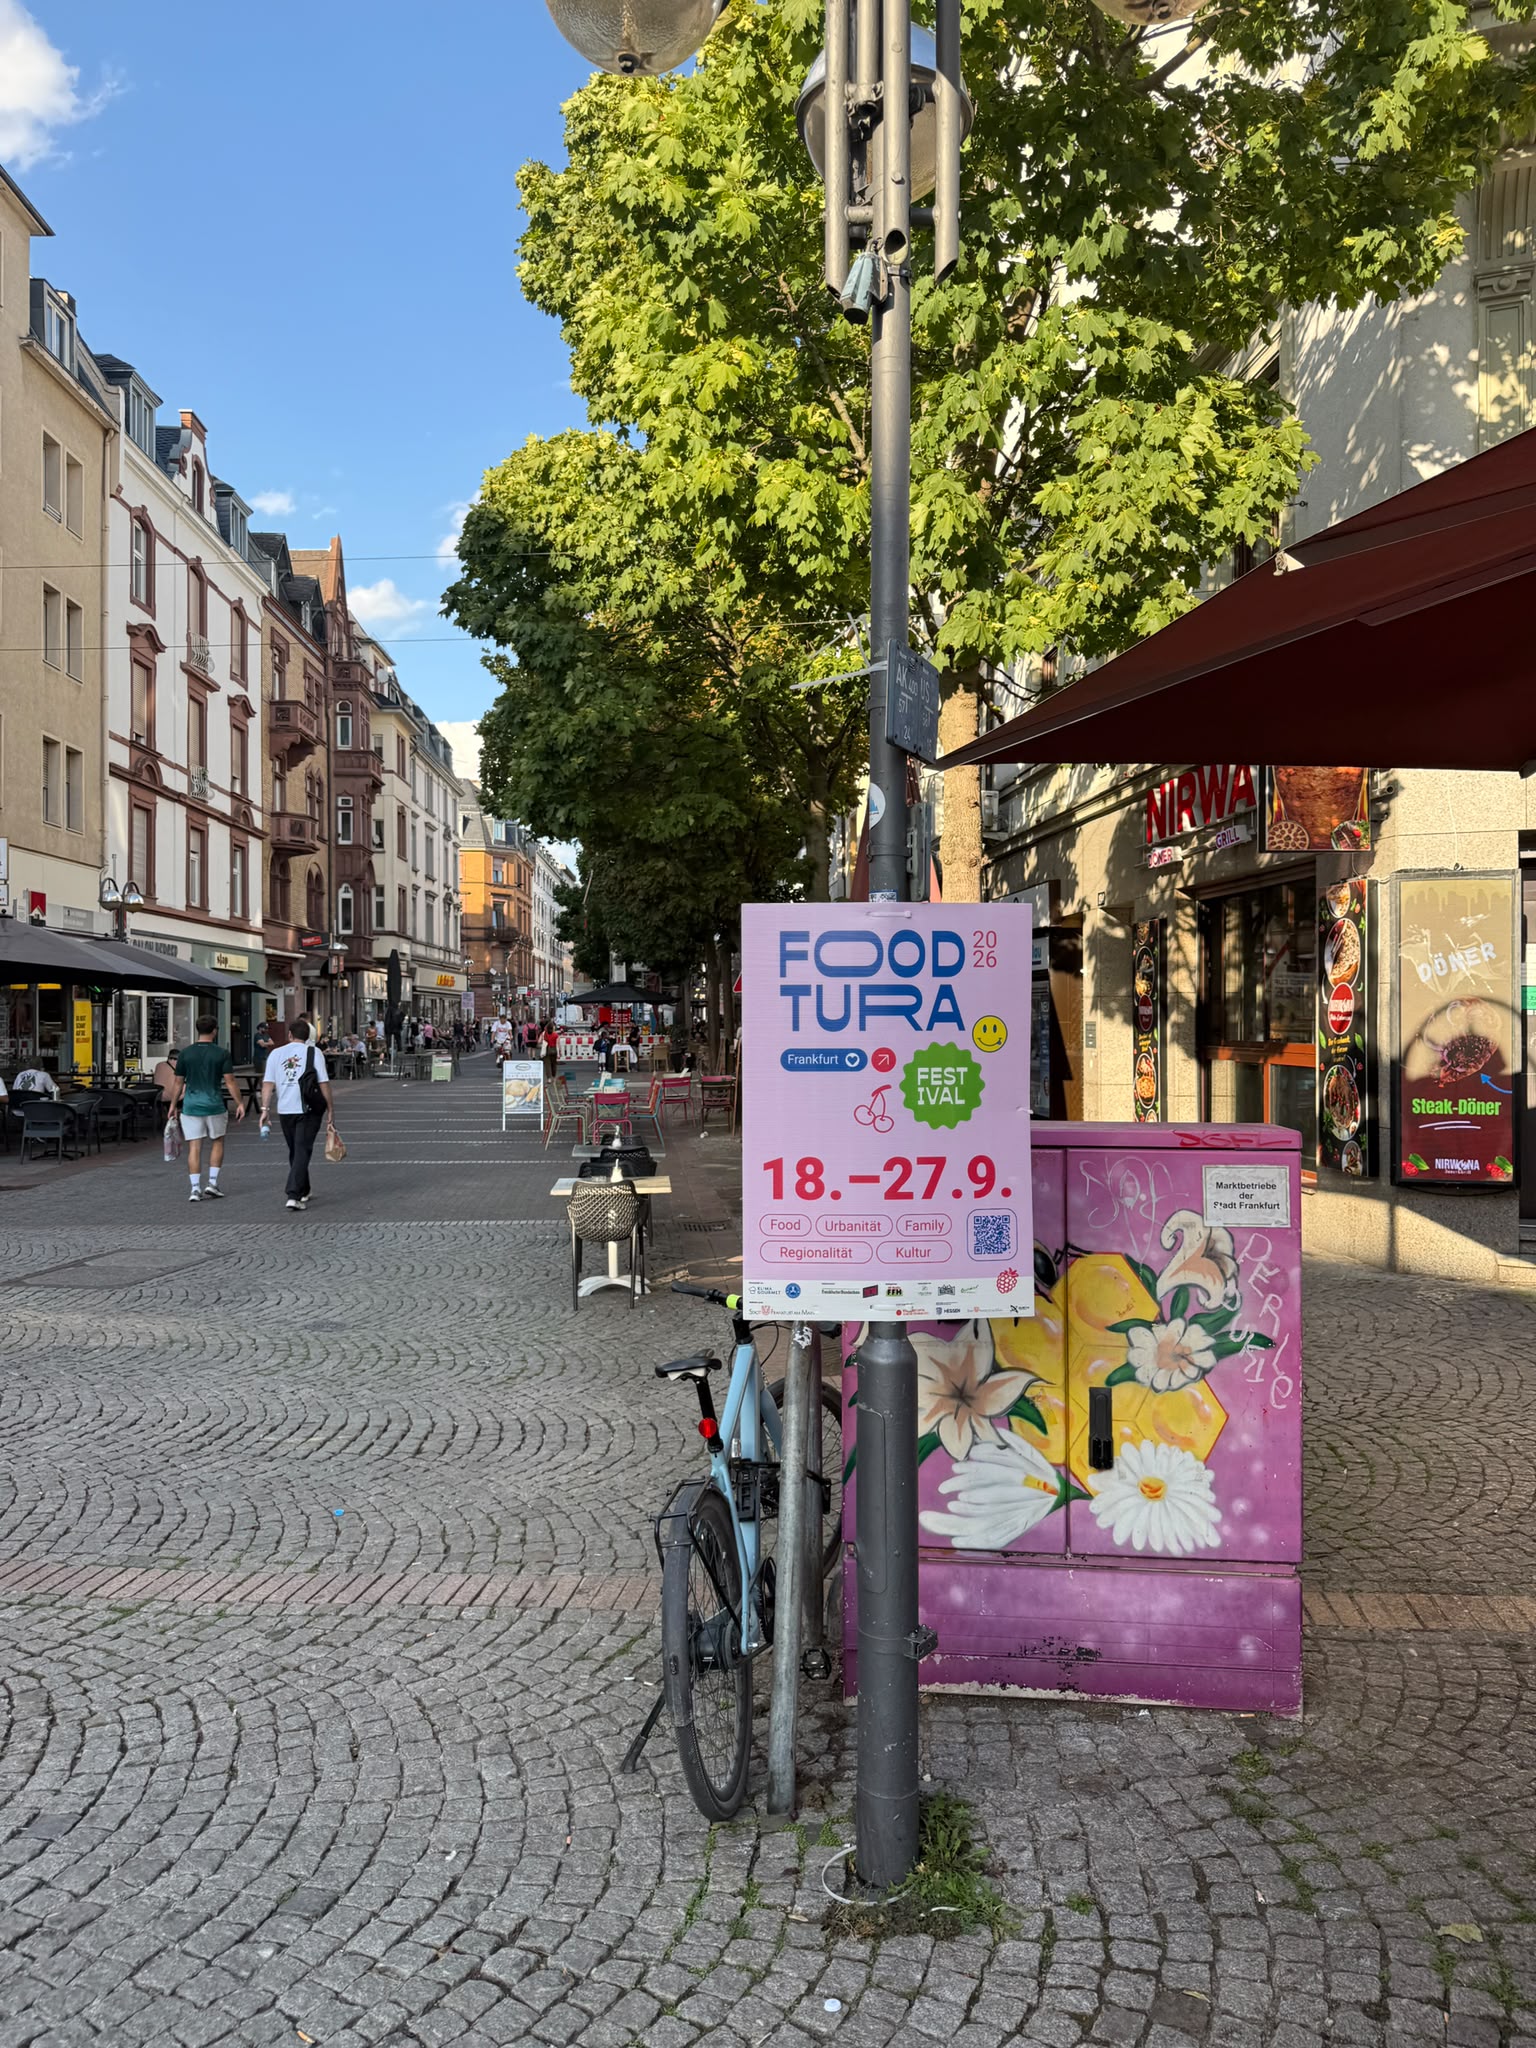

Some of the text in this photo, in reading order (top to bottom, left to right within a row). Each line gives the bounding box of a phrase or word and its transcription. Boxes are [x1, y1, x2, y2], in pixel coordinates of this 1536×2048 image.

[896, 663, 908, 689] AK
[1216, 827, 1240, 848] GRILL
[973, 931, 997, 948] 20
[780, 929, 965, 978] FOOD
[973, 950, 997, 968] 26
[1418, 942, 1497, 983] DÖNER
[780, 984, 966, 1032] TURA
[787, 1054, 839, 1065] Frankfurt
[917, 1067, 968, 1086] FEST
[917, 1087, 966, 1105] IVAL
[1412, 1098, 1502, 1116] Steak-Döner
[1215, 1182, 1277, 1190] Marktbetriebe
[770, 1219, 801, 1231] Food
[825, 1219, 882, 1232] Urbanität
[905, 1219, 944, 1234] Family
[780, 1245, 853, 1261] Regionalität
[896, 1246, 932, 1259] Kultur
